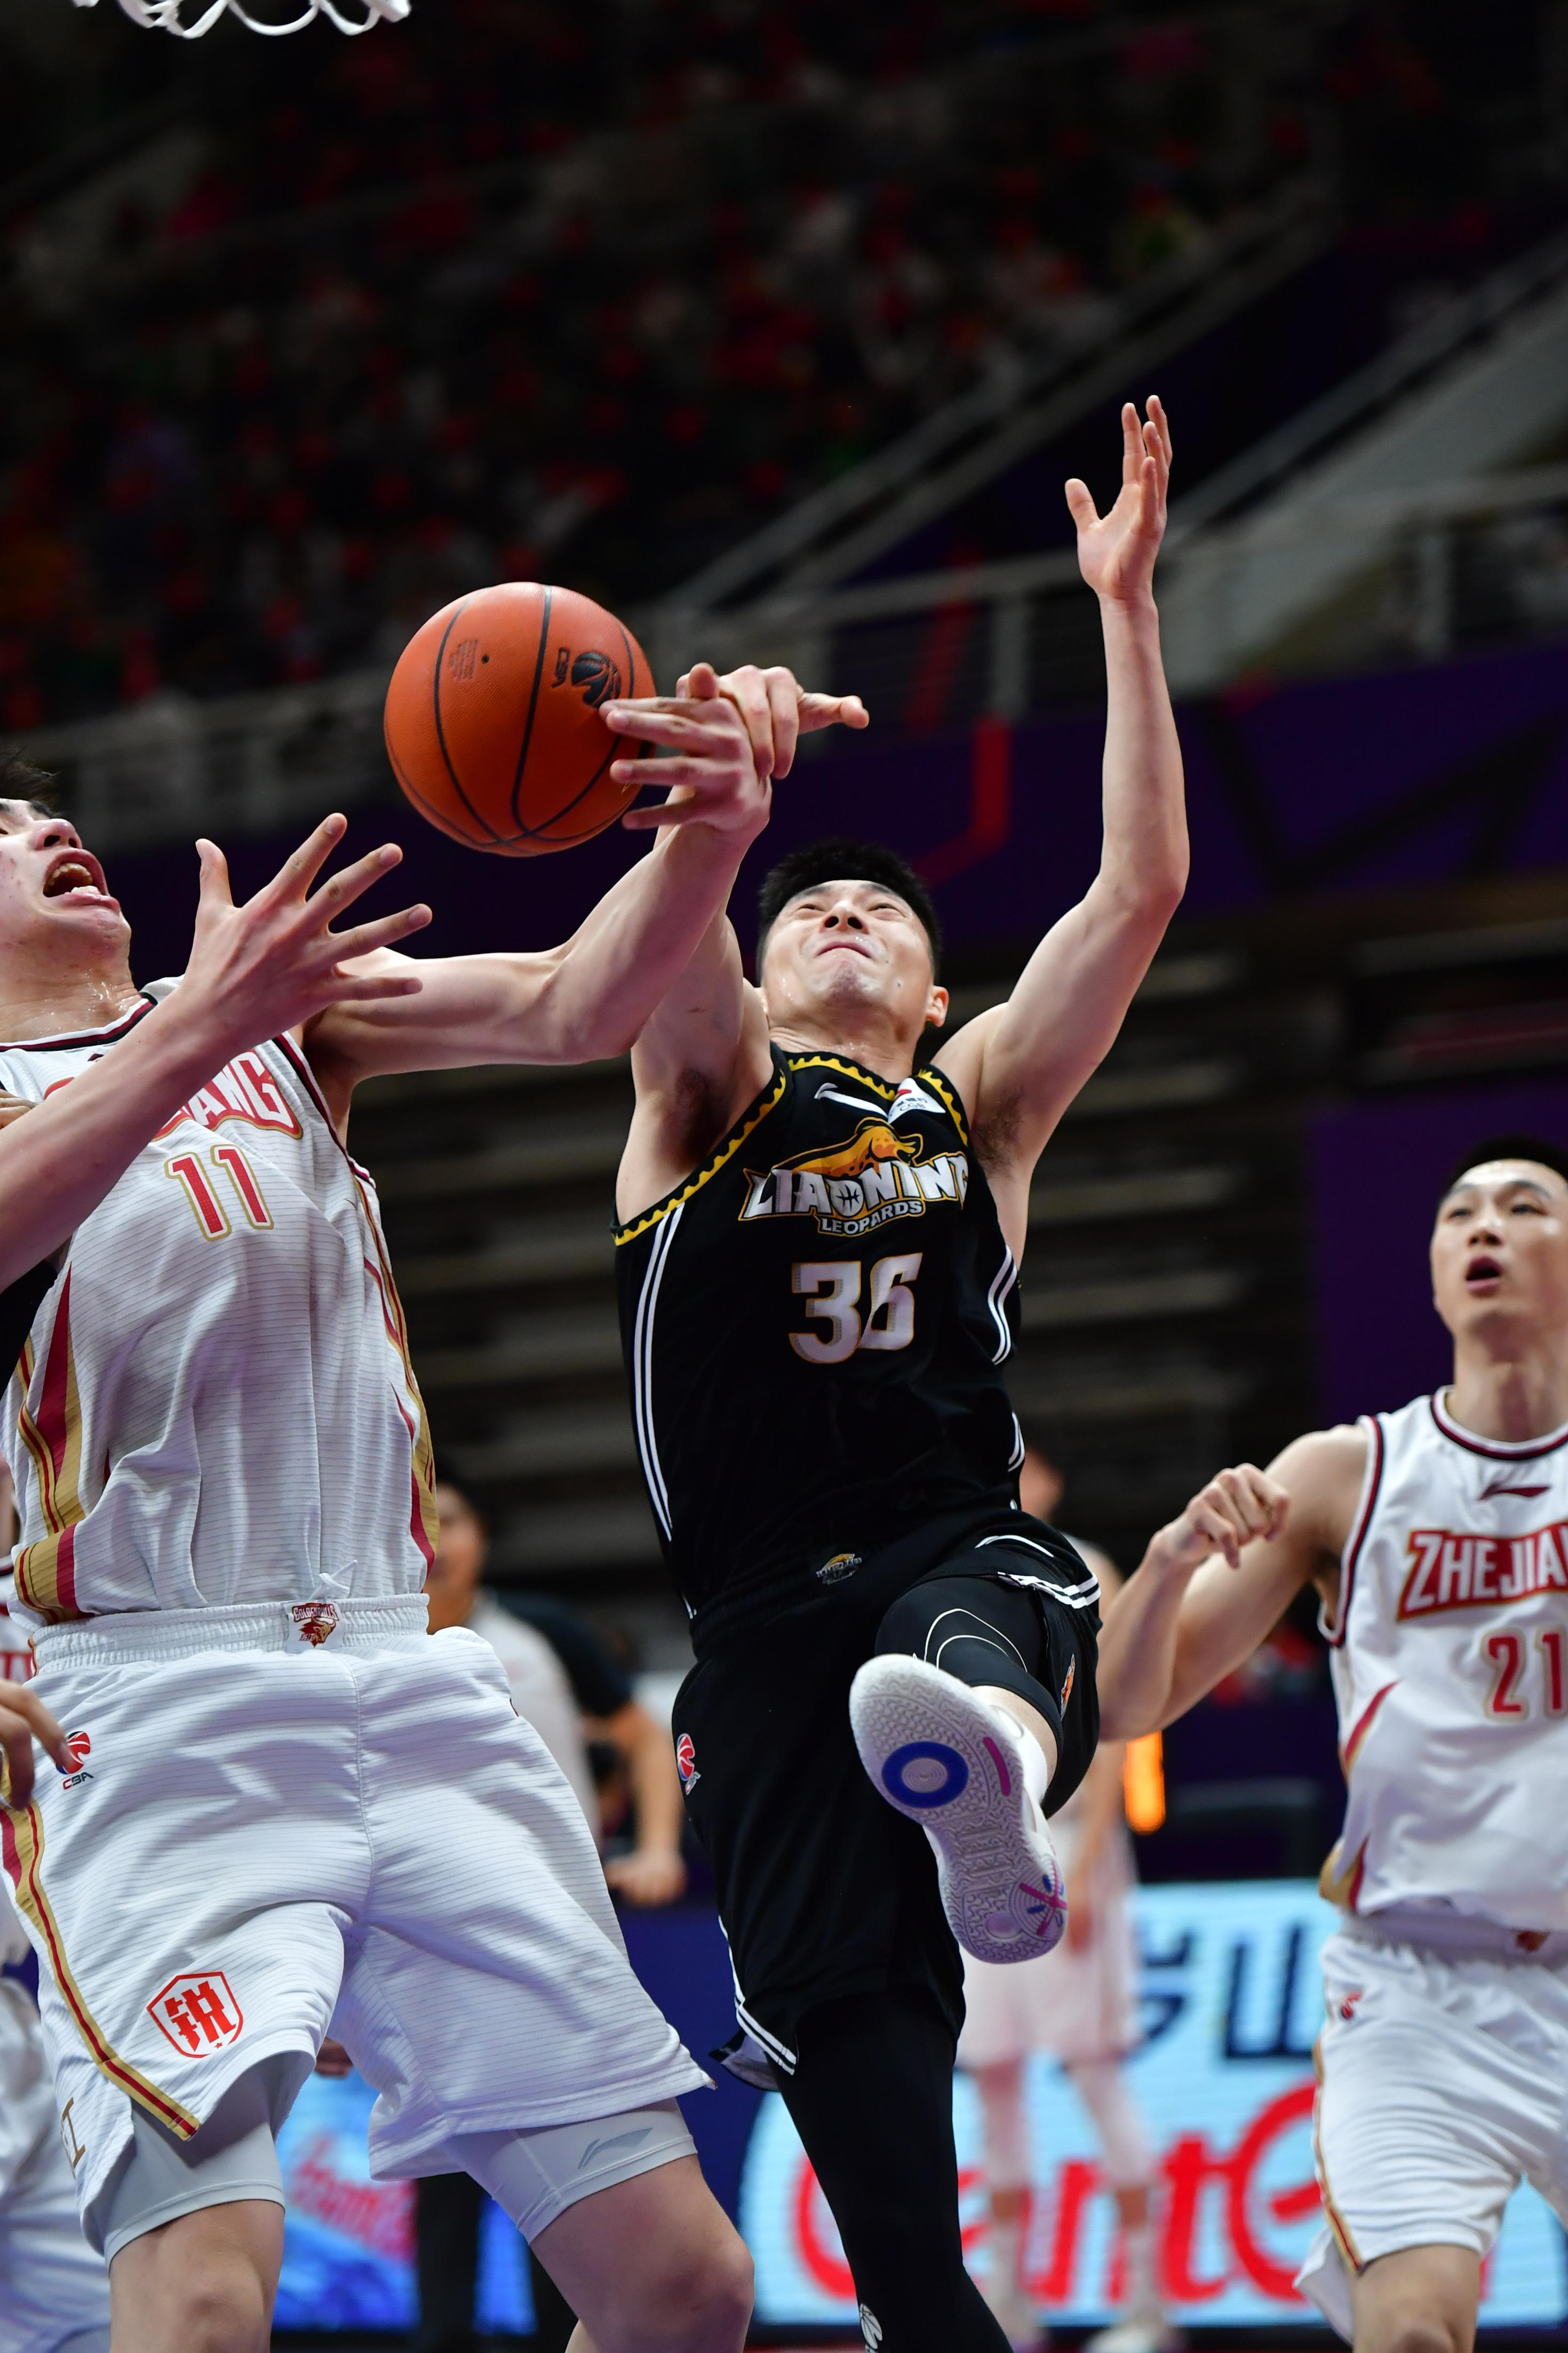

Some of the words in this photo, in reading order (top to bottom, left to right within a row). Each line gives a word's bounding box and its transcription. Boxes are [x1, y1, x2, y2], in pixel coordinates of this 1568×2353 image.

[168, 1146, 272, 1239] 11
[821, 1200, 923, 1235] LEOPARDS
[789, 1253, 922, 1364] 36
[1405, 1524, 1568, 1612] ZHEJIA
[1484, 1628, 1566, 1717] 21
[62, 1772, 94, 1791] CBA
